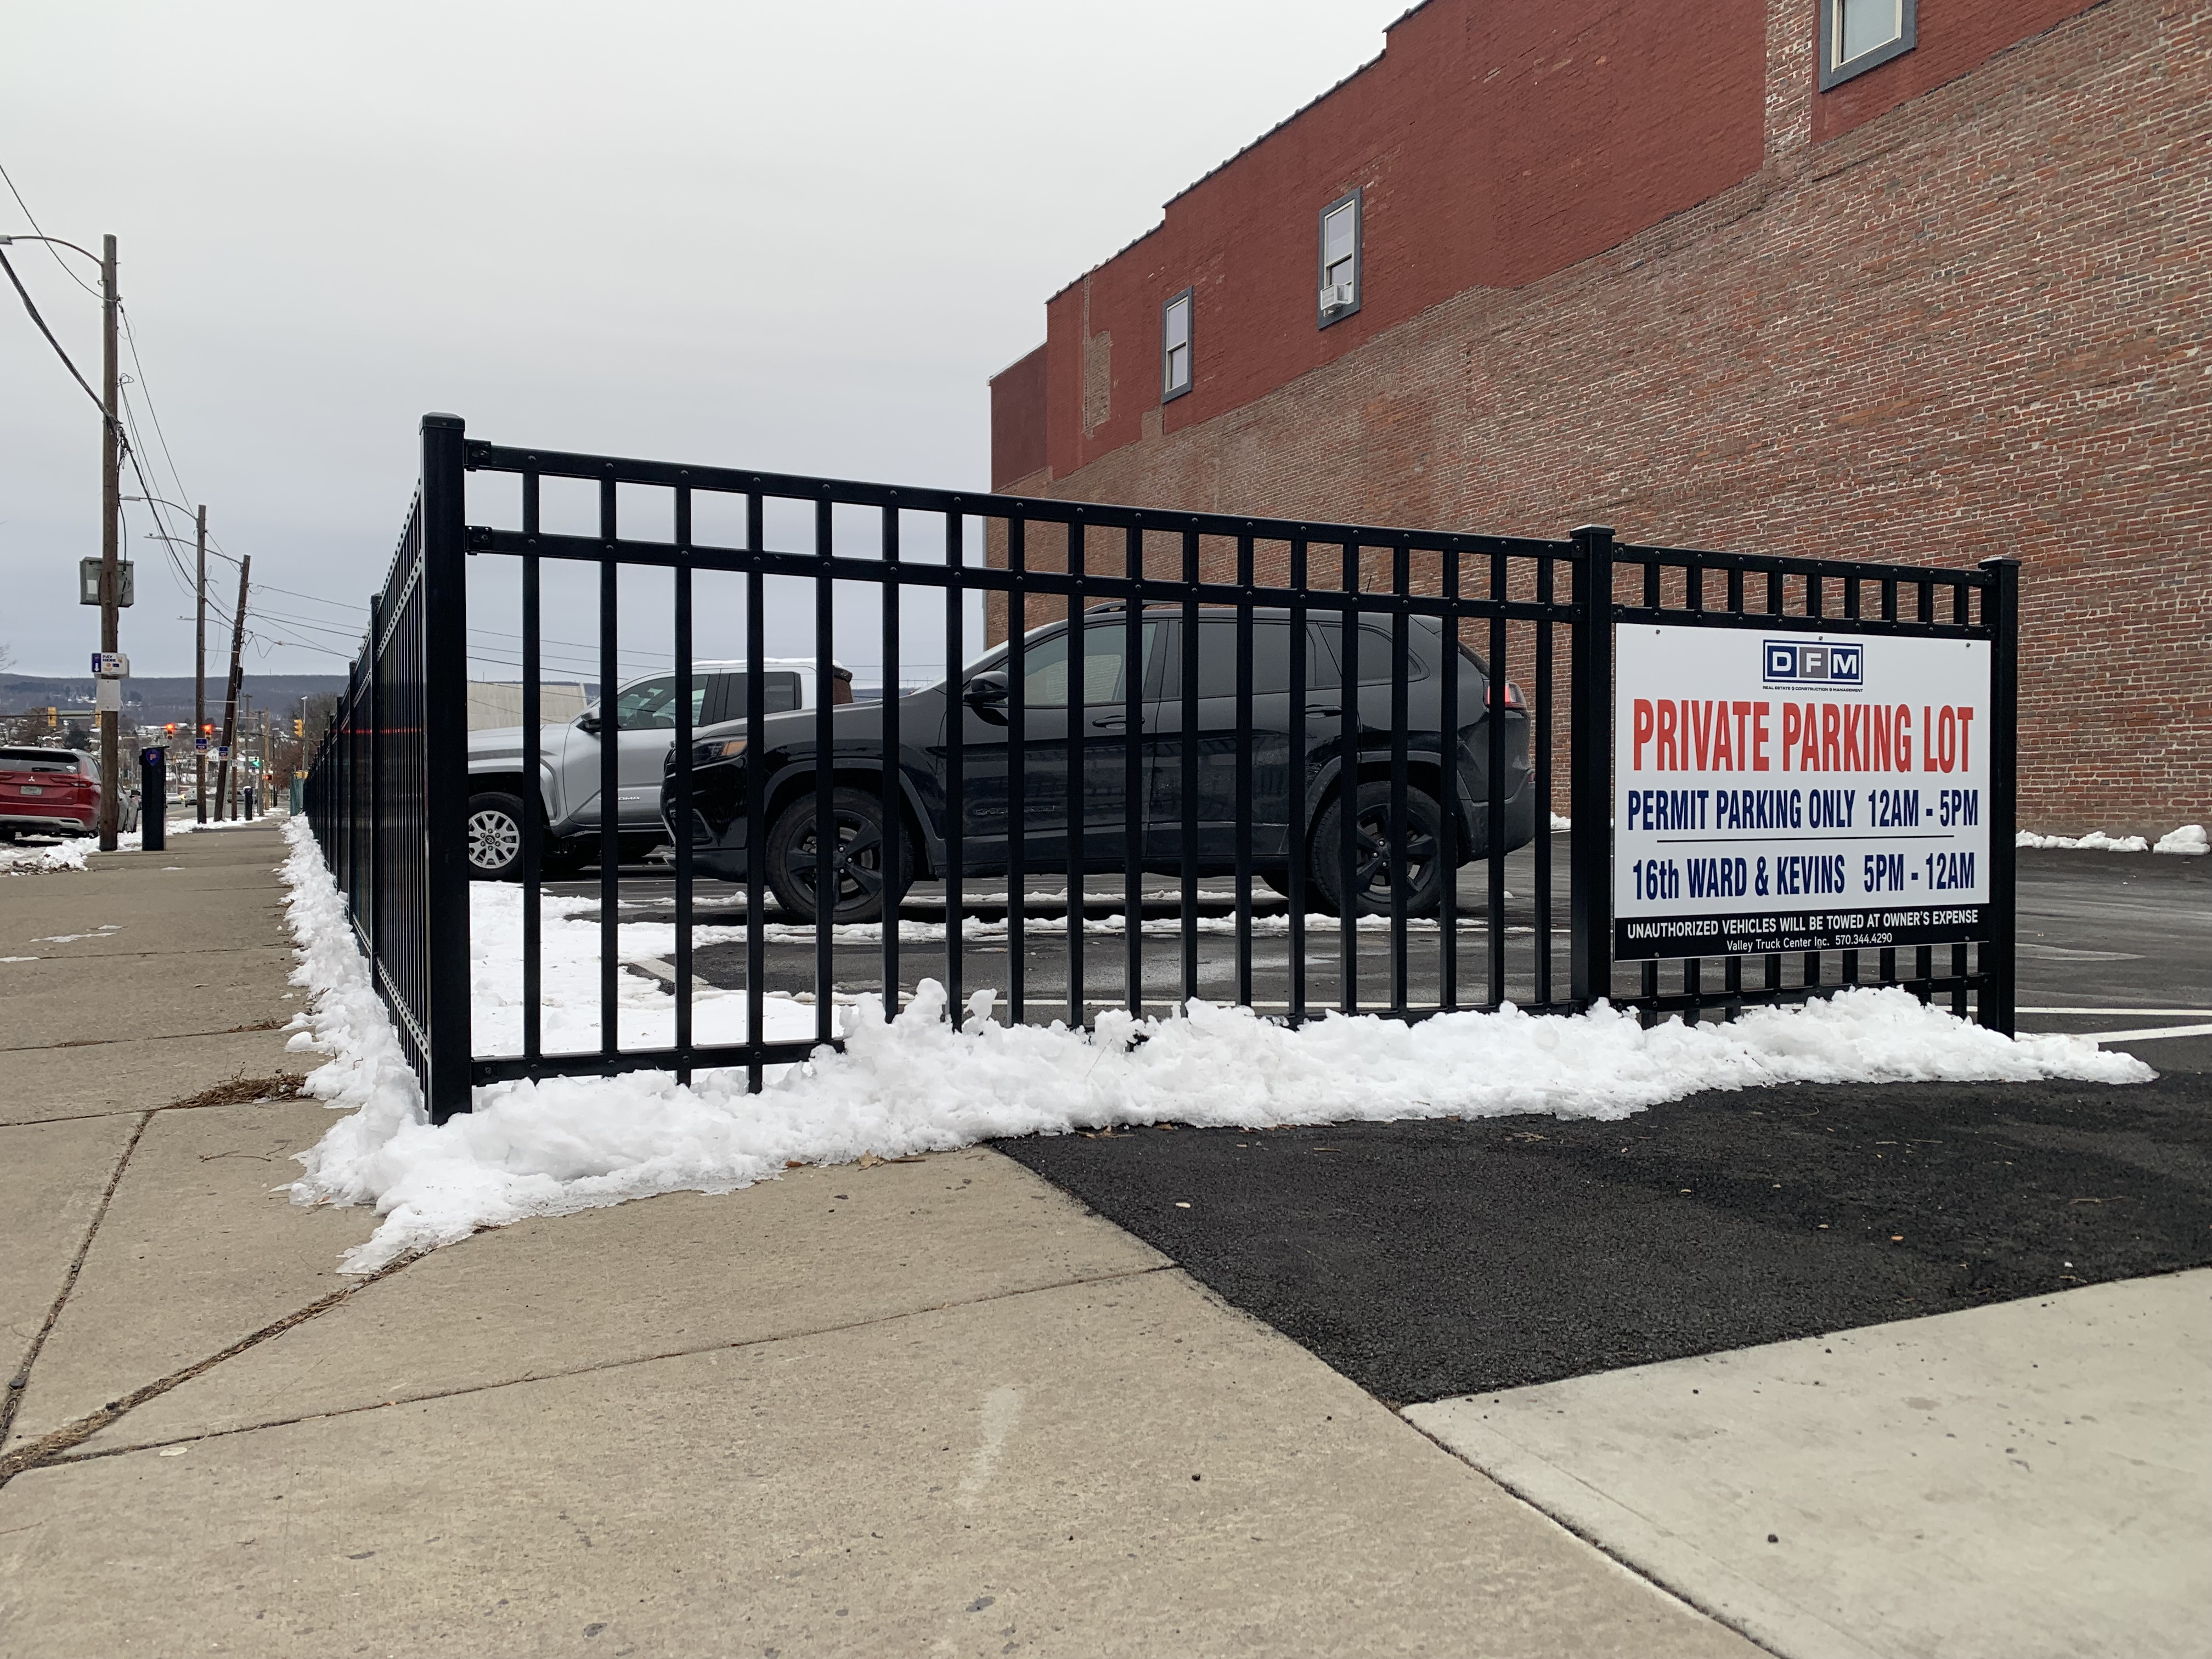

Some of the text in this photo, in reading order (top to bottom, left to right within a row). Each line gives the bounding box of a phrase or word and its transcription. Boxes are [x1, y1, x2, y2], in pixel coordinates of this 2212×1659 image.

[1773, 651, 1858, 674] DFM
[1634, 699, 1974, 773] PRIVATE PARKING LOT
[1628, 789, 1978, 830] PERMIT PARKING ONLY 12AM - 5PM
[1633, 852, 1974, 900] 16th WARD & KEVINS 5PM - 12AM
[1628, 909, 1978, 939] UNAUTHORIZED VEHICLES WILL BE TOWED AT OWNER'S EXPENSE
[1726, 933, 1893, 953] Valley Truck Center Inc. 570.344.4290
